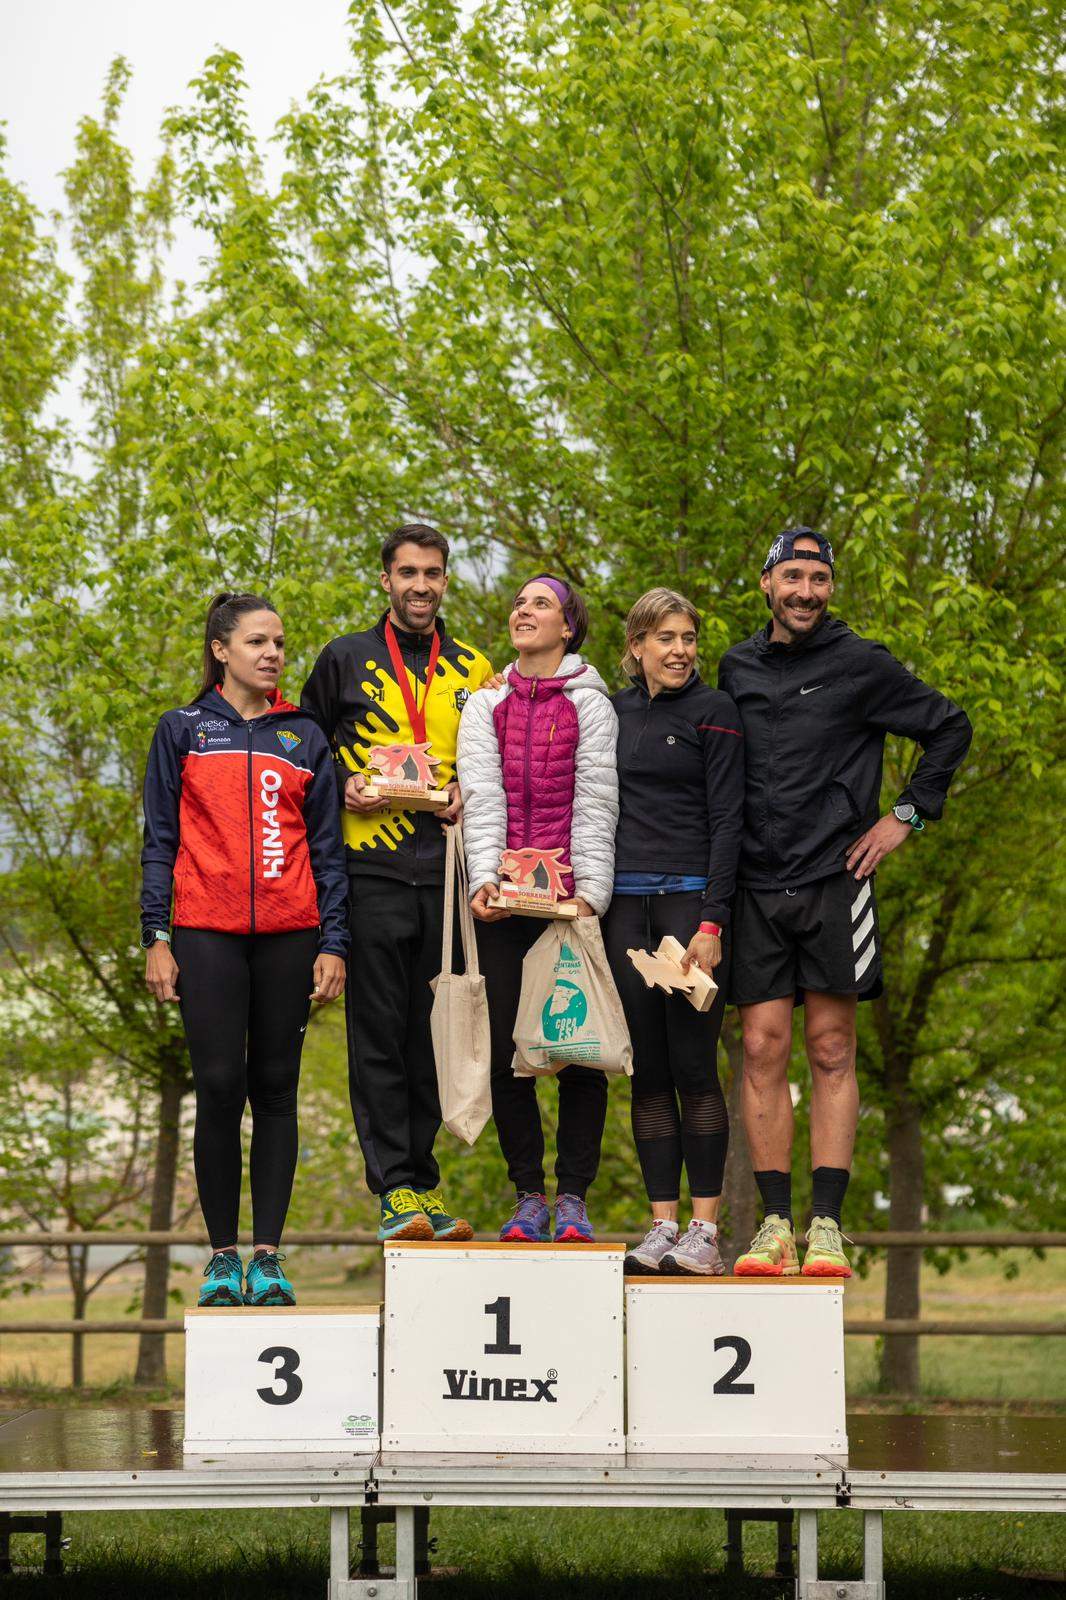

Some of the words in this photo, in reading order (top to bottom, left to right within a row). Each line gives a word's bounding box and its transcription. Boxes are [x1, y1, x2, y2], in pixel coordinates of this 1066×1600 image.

[260, 769, 284, 878] HINACO
[484, 1296, 521, 1355] 1
[256, 1346, 303, 1406] 3
[713, 1335, 755, 1395] 2
